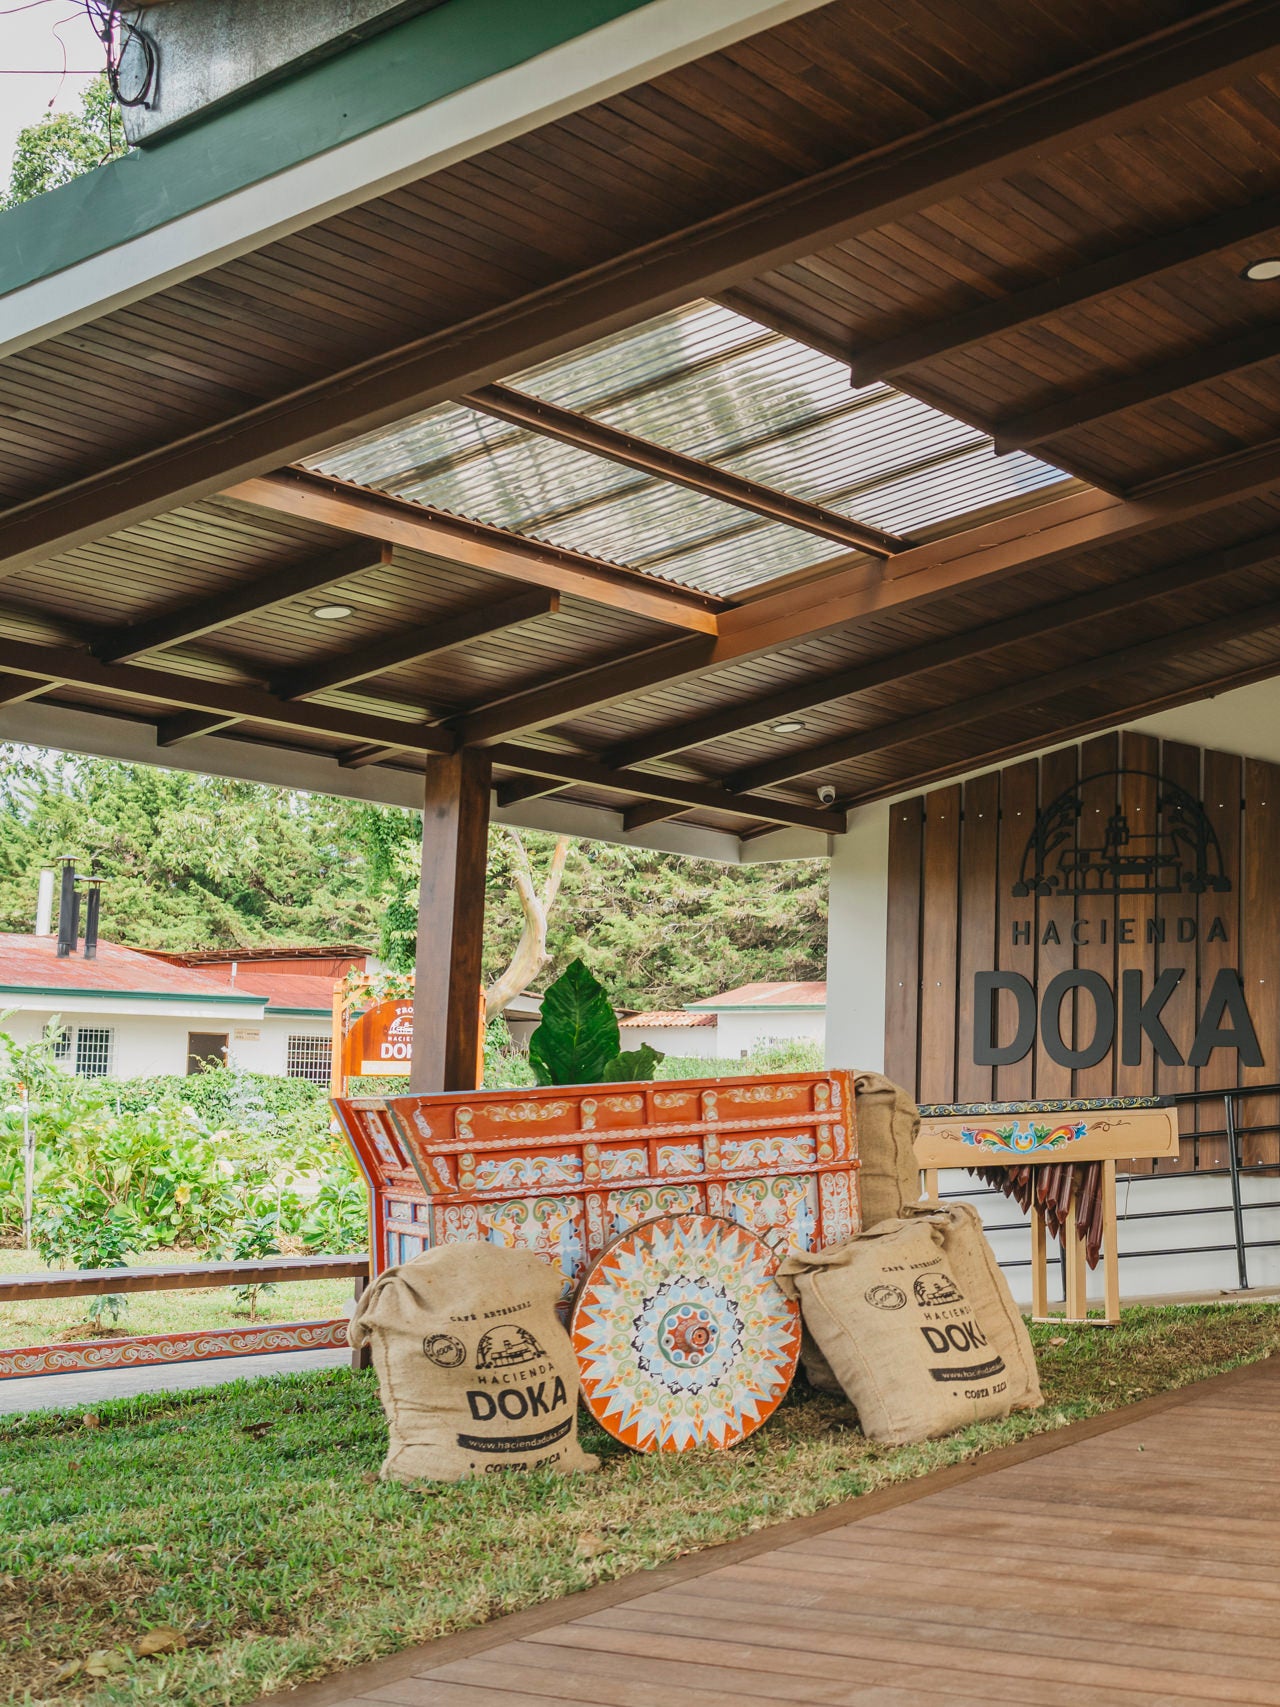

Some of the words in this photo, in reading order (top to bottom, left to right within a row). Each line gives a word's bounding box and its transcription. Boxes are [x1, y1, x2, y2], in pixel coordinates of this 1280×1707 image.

[1012, 916, 1229, 946] HACIENDA
[973, 968, 1265, 1070] DOKA
[381, 1043, 412, 1059] DO
[477, 1362, 555, 1384] HACIENDA
[466, 1375, 568, 1421] DOKA
[964, 1388, 989, 1399] COSTA
